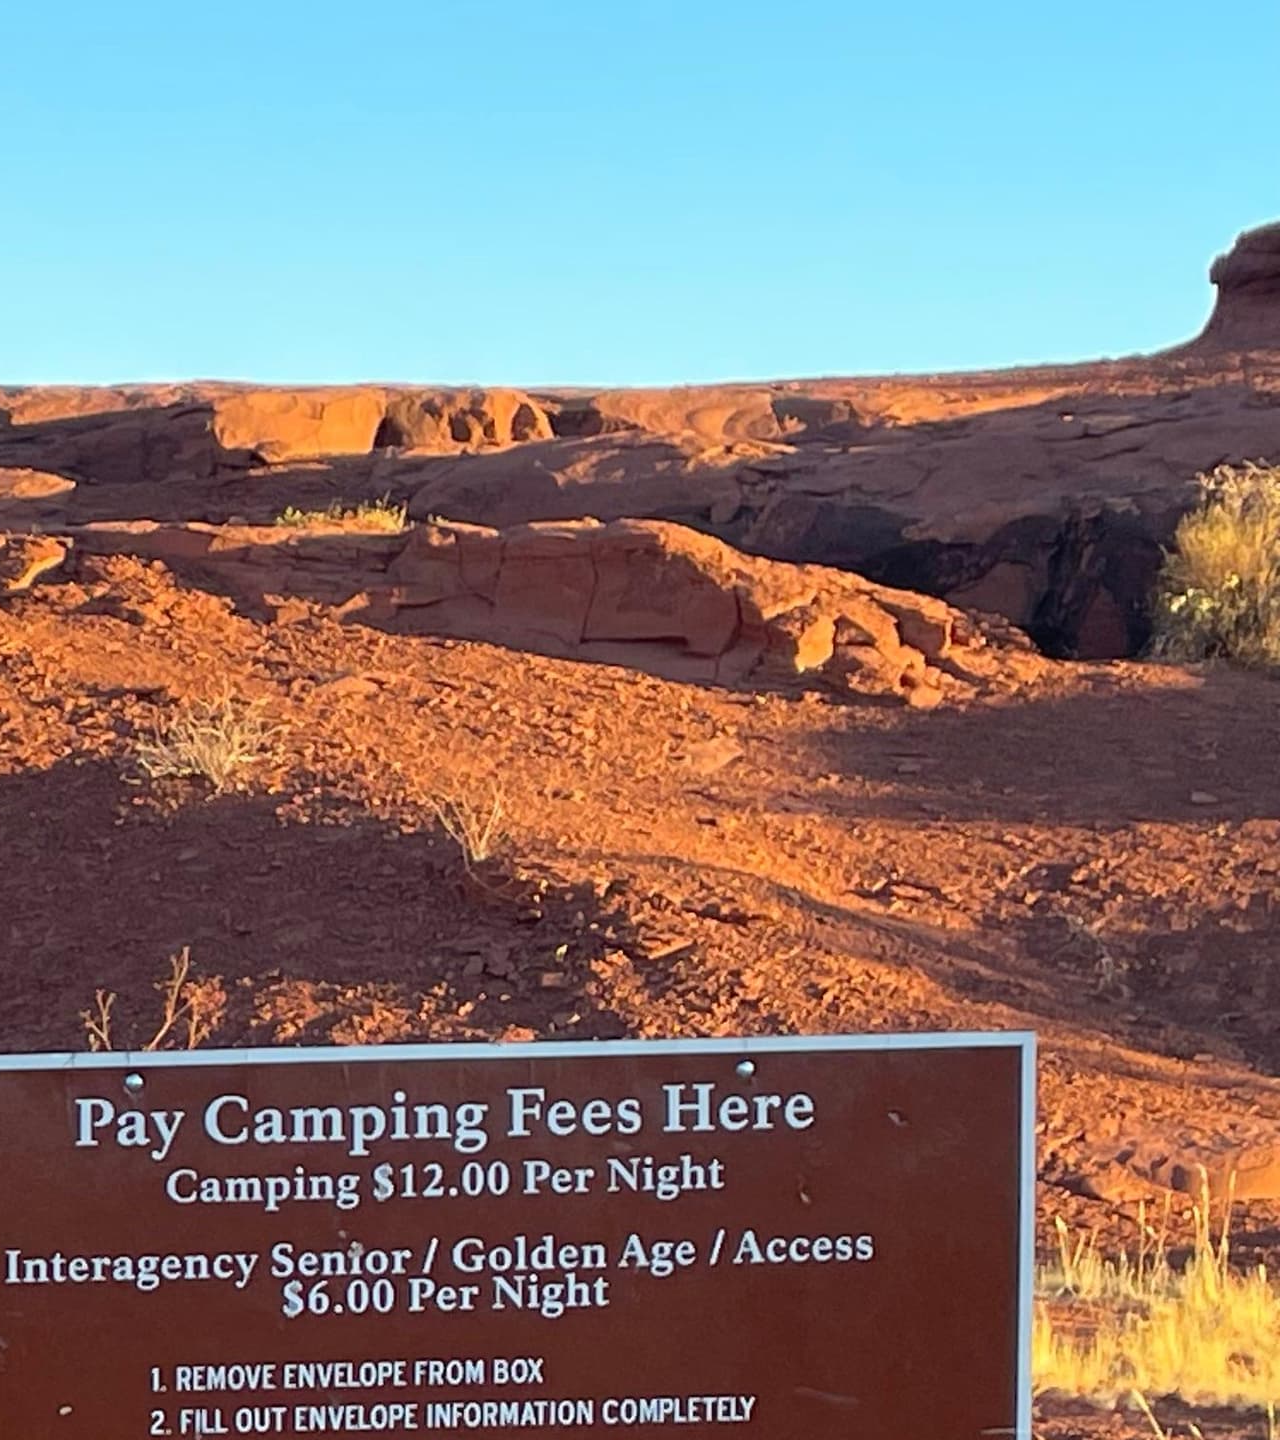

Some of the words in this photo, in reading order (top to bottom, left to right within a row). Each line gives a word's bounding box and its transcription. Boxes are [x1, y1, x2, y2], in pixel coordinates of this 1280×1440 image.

[74, 1098, 185, 1161] Pay
[204, 1090, 489, 1156] Camping
[506, 1088, 642, 1137] Fees
[662, 1083, 814, 1132] Here
[166, 1165, 361, 1211] Camping
[372, 1161, 510, 1202] $12.00
[523, 1160, 595, 1195] Per
[606, 1154, 725, 1201] Night
[5, 1249, 259, 1291] Interagency
[271, 1241, 412, 1278] Senior
[422, 1237, 439, 1274] /
[452, 1235, 607, 1273] Golden
[618, 1233, 696, 1277] Age
[709, 1228, 726, 1266] /
[732, 1230, 874, 1264] Access
[282, 1278, 395, 1318] $6.00
[408, 1278, 479, 1312] Per
[491, 1271, 610, 1318] Night
[151, 1367, 167, 1392] 1.
[176, 1364, 277, 1392] REMOVE
[283, 1360, 407, 1389] ENVELOPE
[414, 1359, 485, 1386] FROM
[493, 1358, 544, 1384] BOX
[150, 1410, 172, 1435] 2.
[180, 1408, 229, 1435] FILL
[235, 1406, 287, 1433] OUT
[294, 1403, 419, 1432] ENVELOPE
[426, 1399, 594, 1429] INFORMATION
[602, 1396, 756, 1425] COMPLETELY
